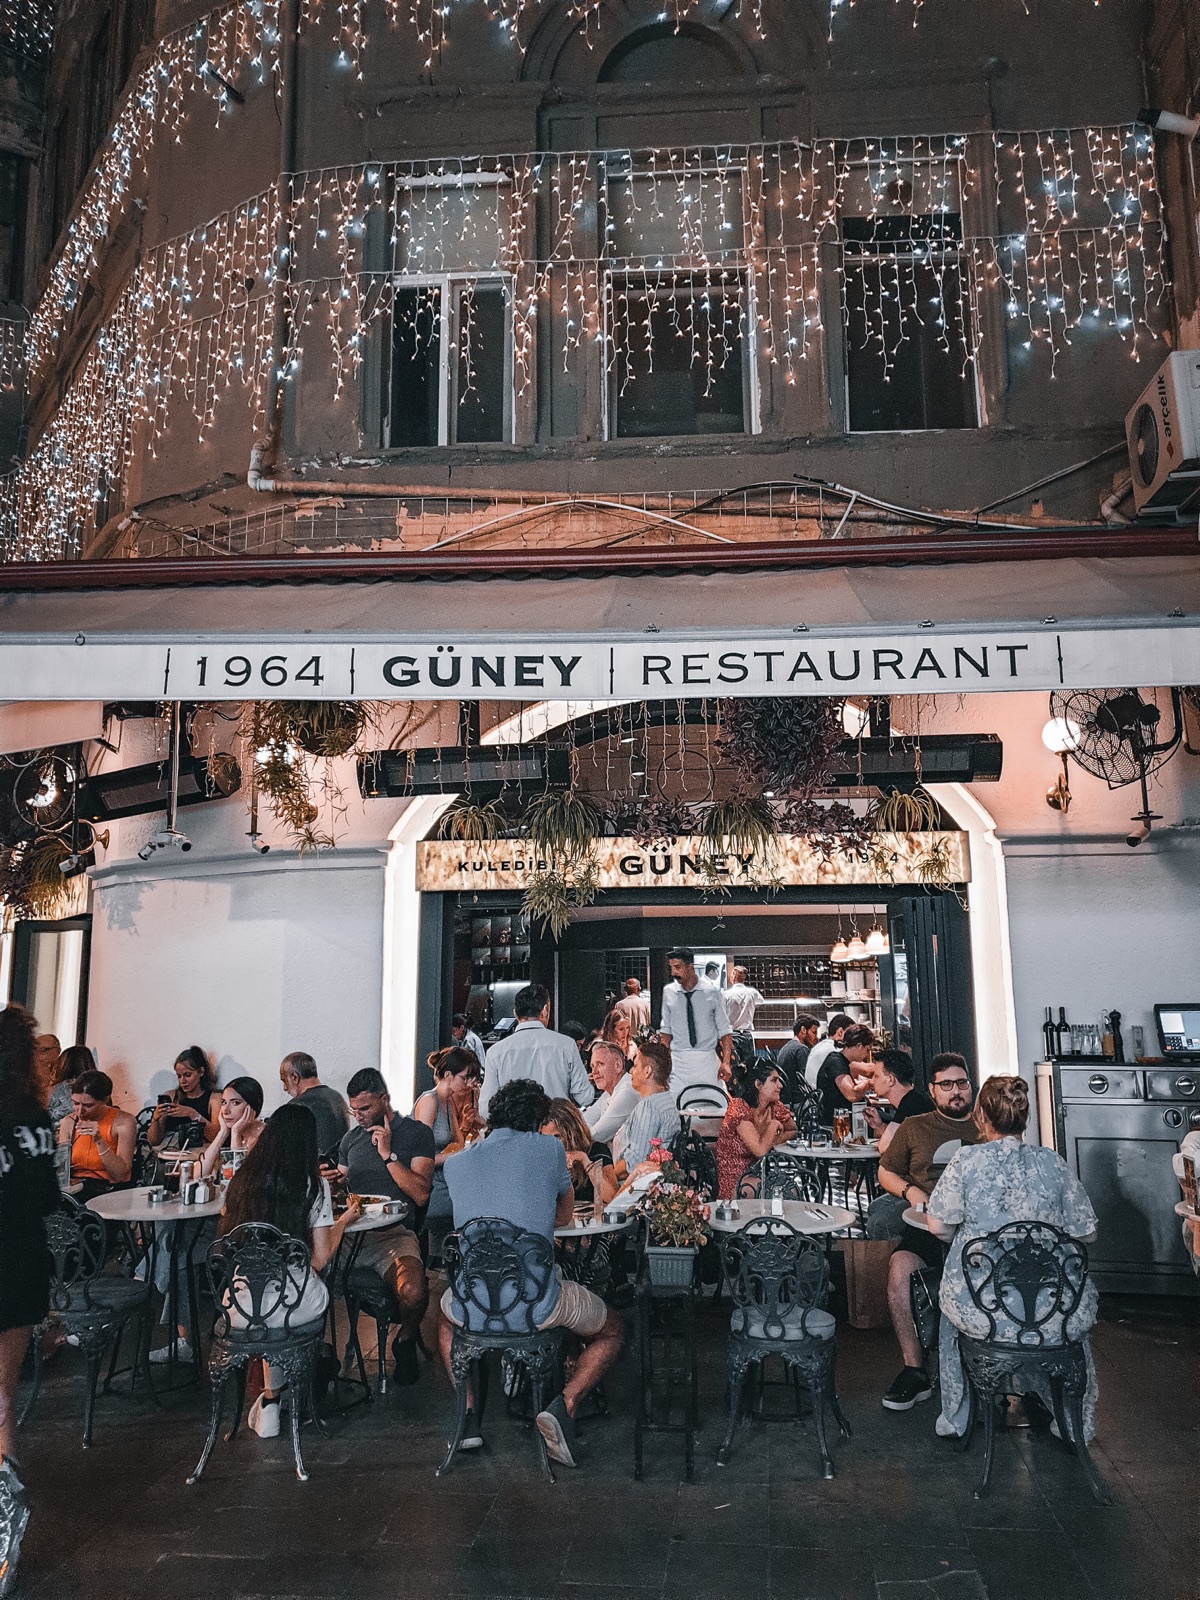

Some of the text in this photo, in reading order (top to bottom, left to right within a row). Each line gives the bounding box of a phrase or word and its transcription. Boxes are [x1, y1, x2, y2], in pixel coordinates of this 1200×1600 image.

[1157, 375, 1172, 438] arçelik
[196, 643, 1029, 687] 1964 GÜNEY RESTAURANT
[619, 846, 756, 876] GÜNEY
[849, 852, 899, 864] 194
